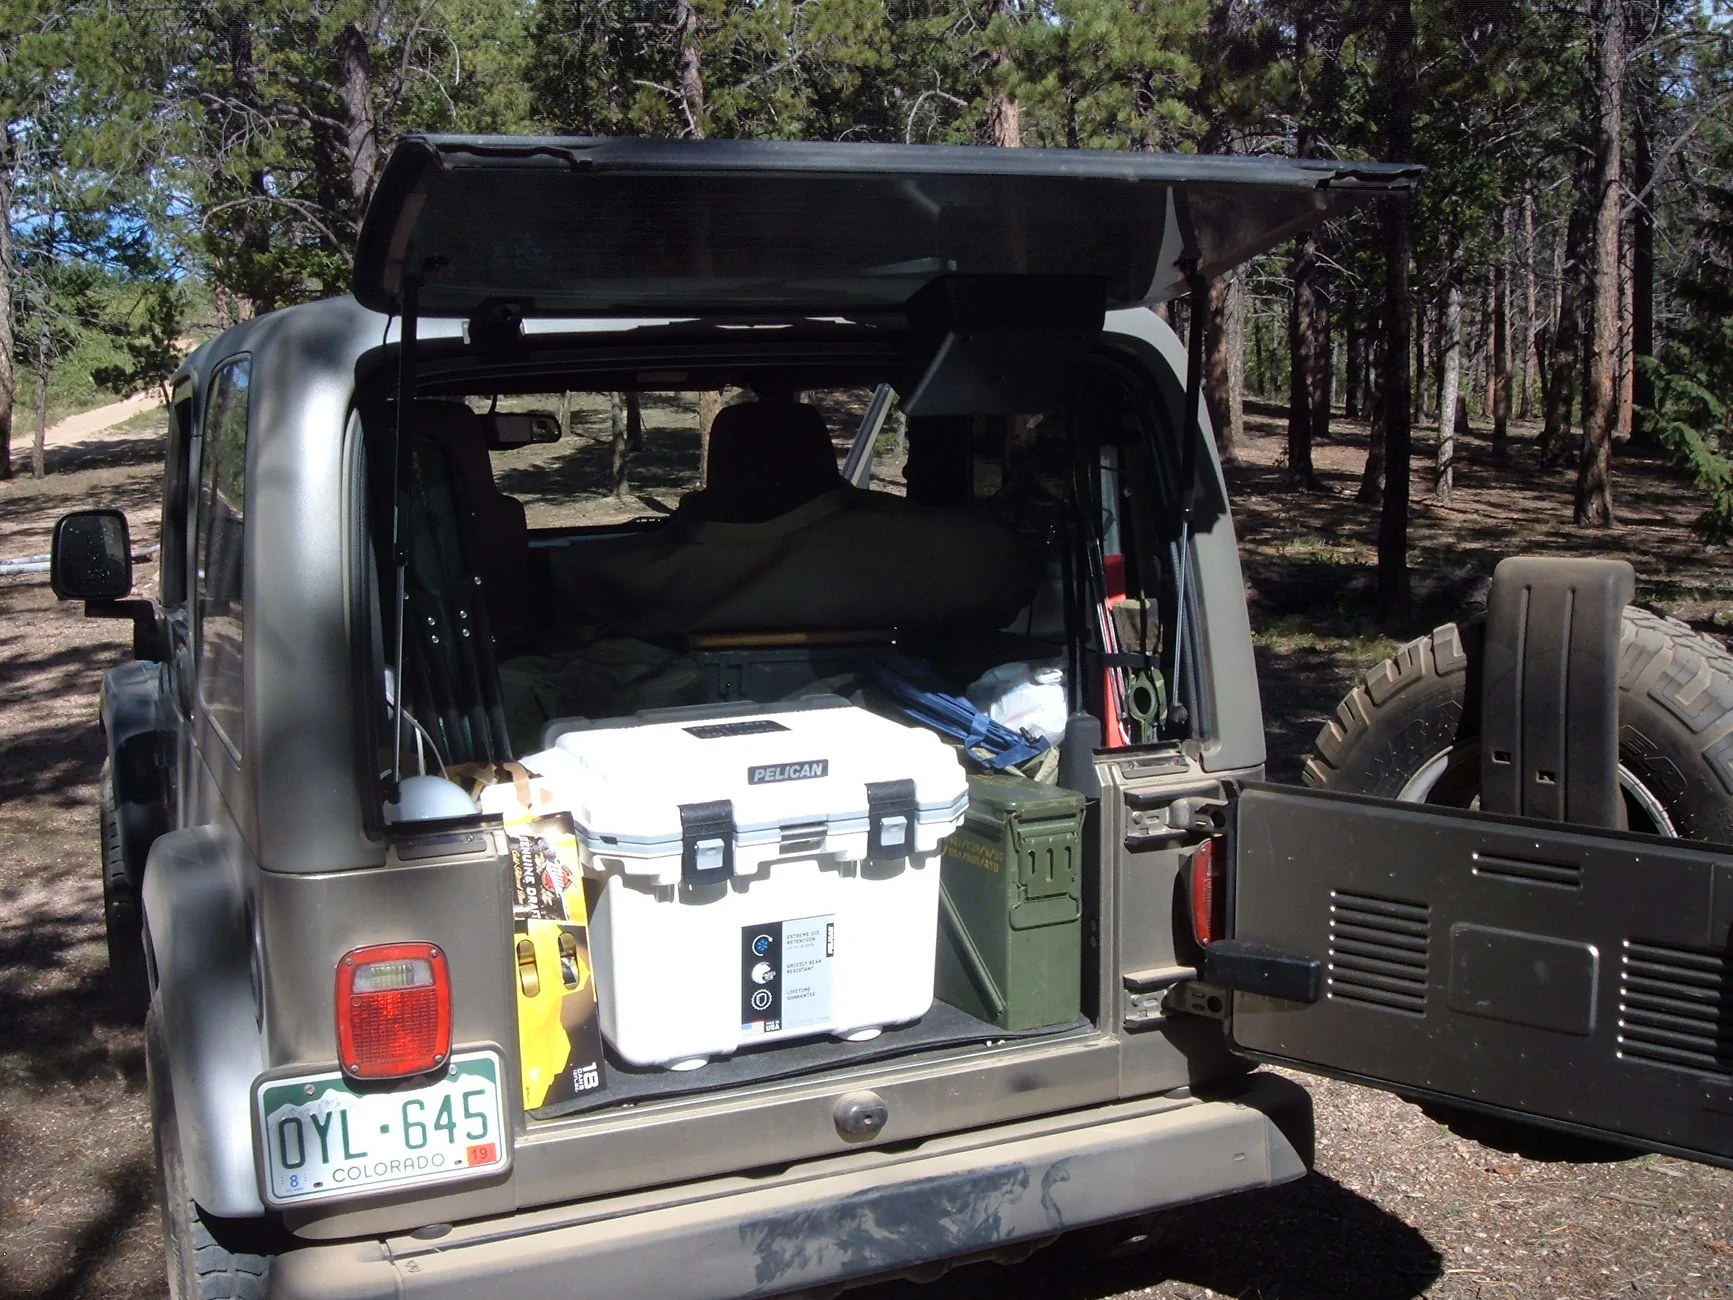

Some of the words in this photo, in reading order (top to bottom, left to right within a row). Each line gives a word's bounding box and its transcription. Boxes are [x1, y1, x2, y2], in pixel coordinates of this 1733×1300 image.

[753, 763, 823, 782] PELICAN
[526, 887, 541, 919] DRAFT
[582, 1061, 599, 1090] 18
[470, 1146, 488, 1161] 19
[332, 1152, 446, 1184] COLORADO
[289, 1174, 300, 1188] 8
